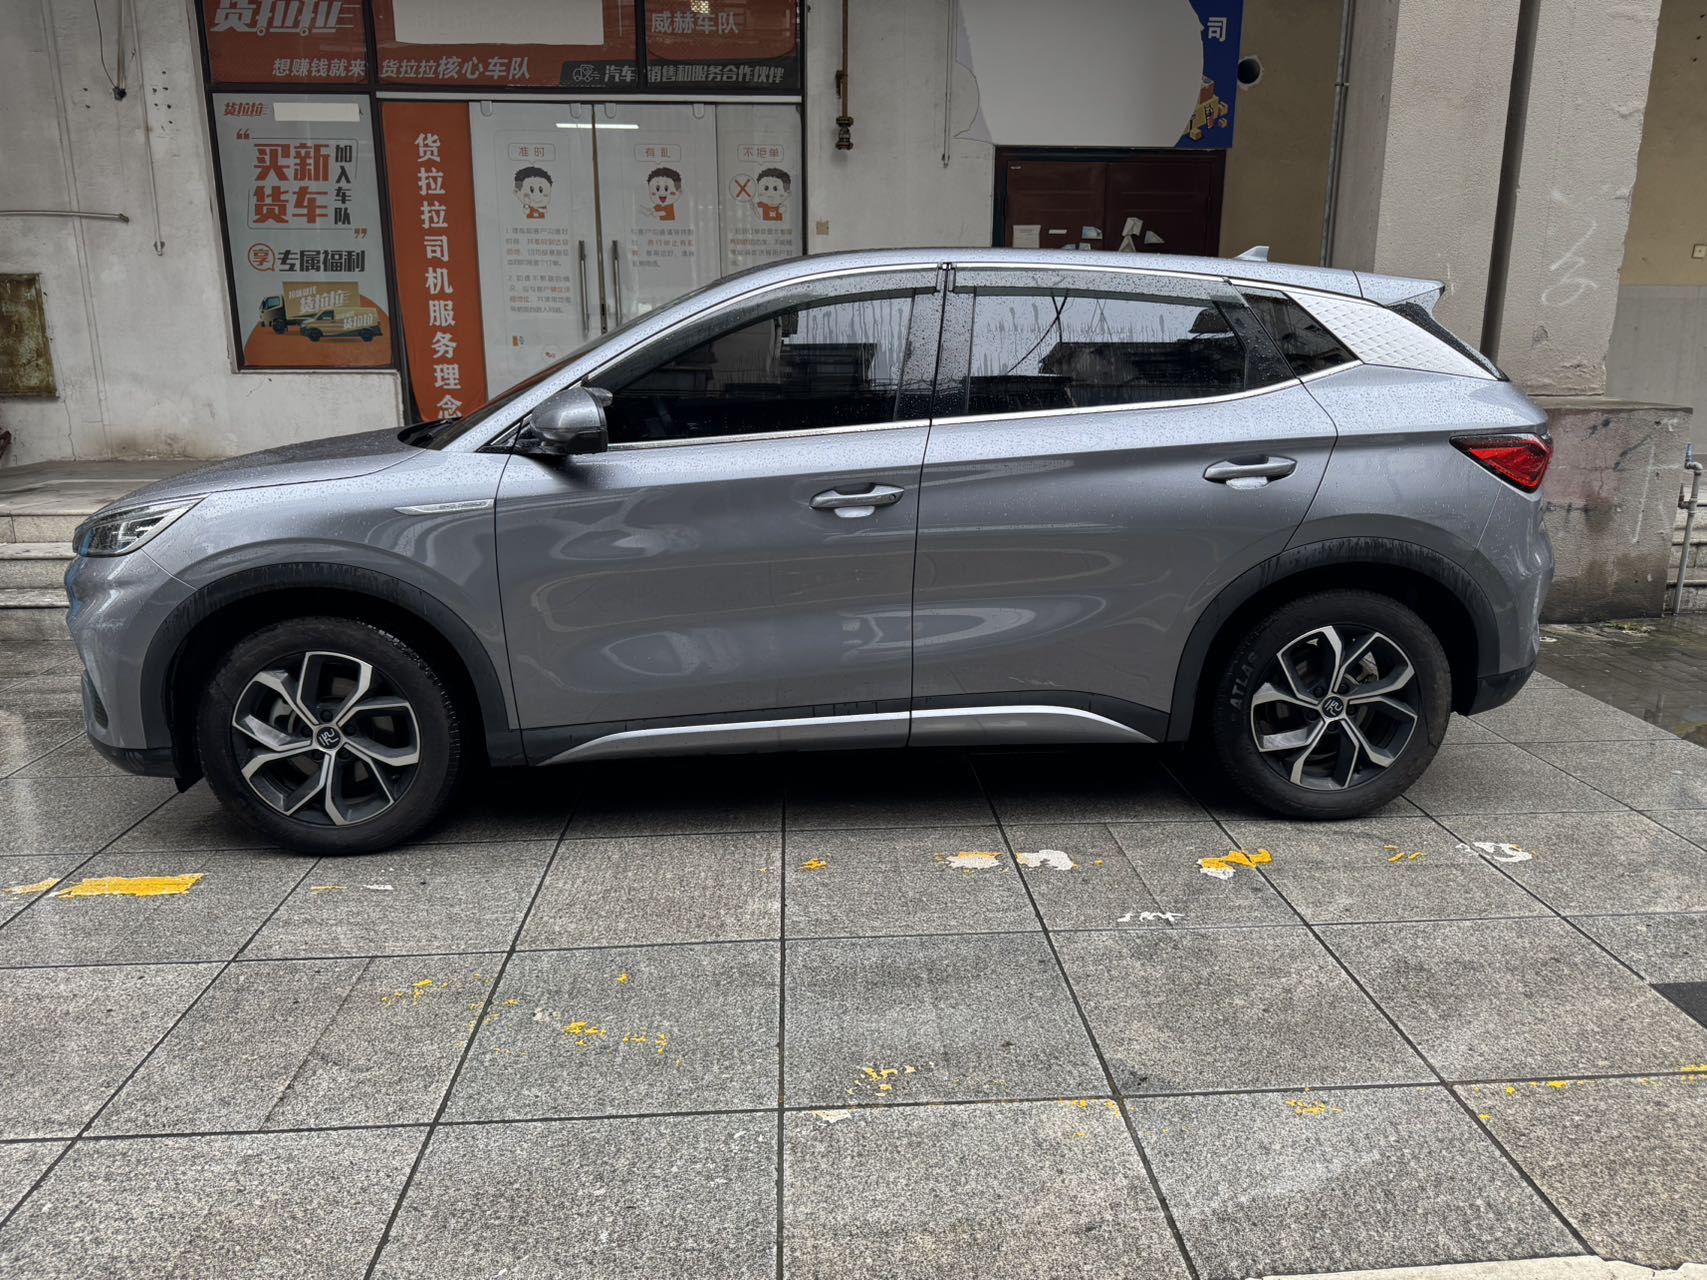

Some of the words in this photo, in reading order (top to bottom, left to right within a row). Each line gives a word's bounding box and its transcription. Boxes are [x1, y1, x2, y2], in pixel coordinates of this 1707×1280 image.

[210, 0, 346, 36] 货拉拉
[651, 11, 738, 34] 威赫车队
[1207, 16, 1227, 42] 司
[272, 58, 366, 77] 想赚钱就来
[381, 56, 530, 80] 货拉拉核心车队
[253, 143, 330, 182] 买新
[334, 144, 352, 226] 加入车队
[252, 185, 329, 225] 货车
[252, 248, 270, 266] 享
[277, 249, 366, 273] 专属福利
[415, 132, 463, 421] 货拉拉司机服务理念
